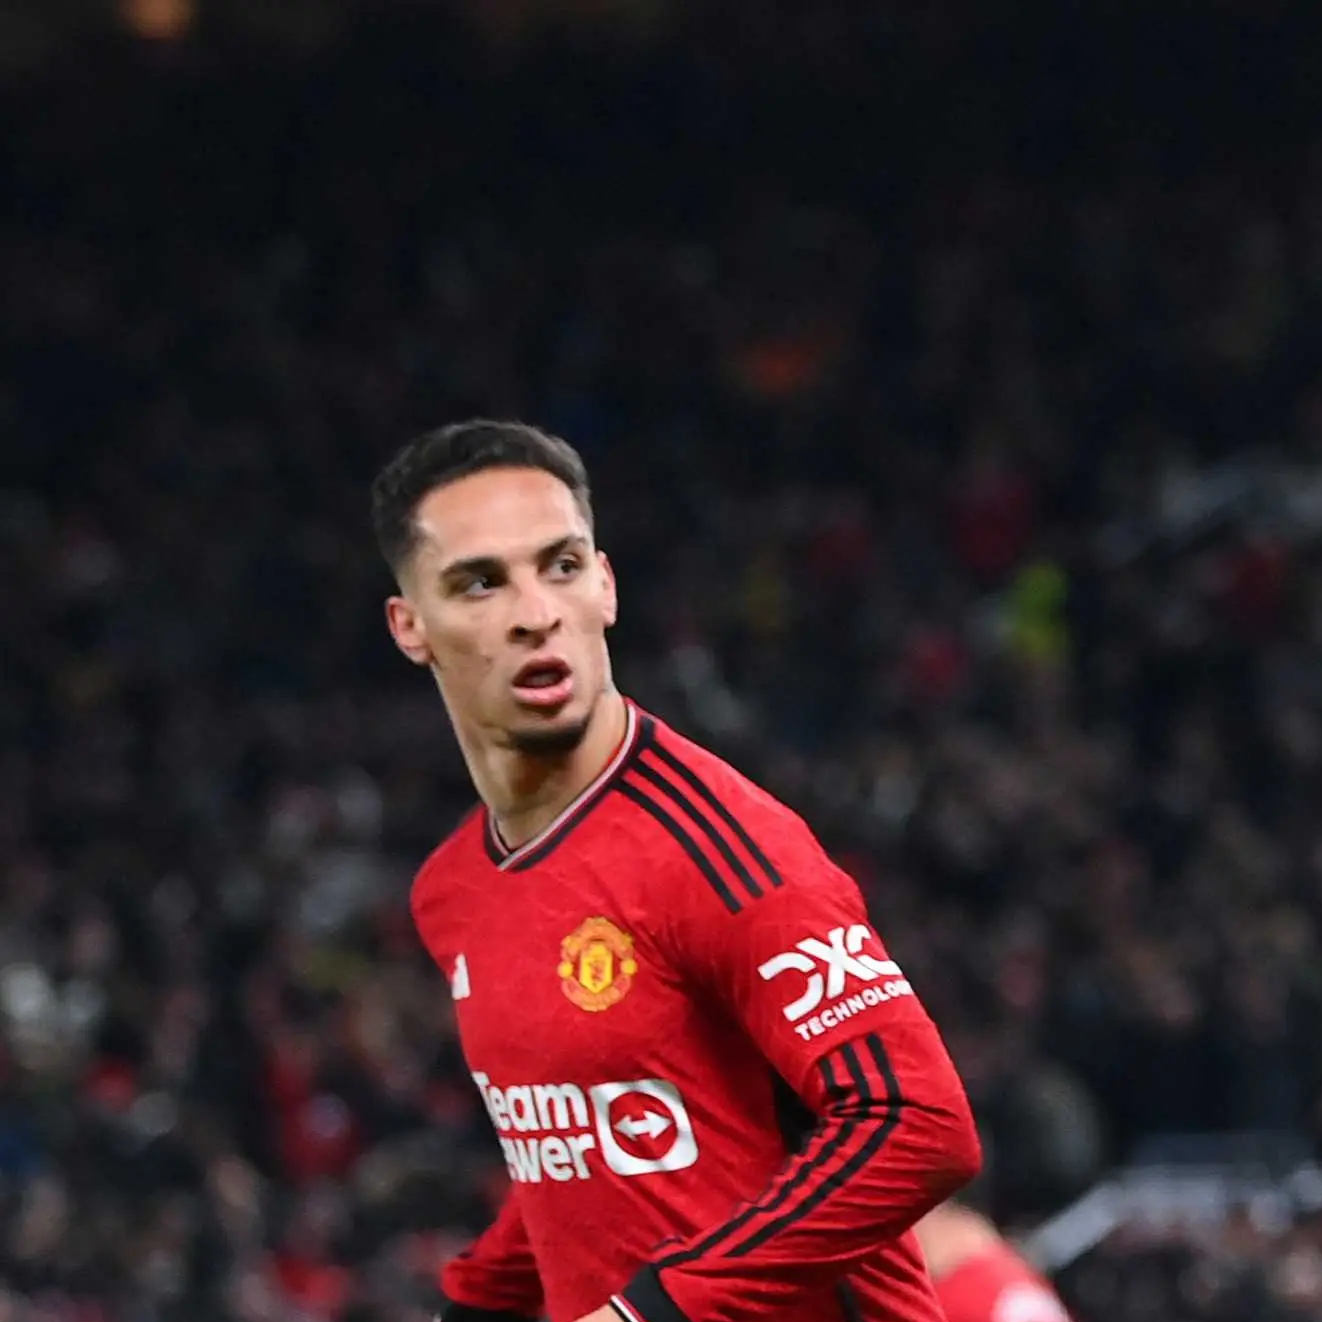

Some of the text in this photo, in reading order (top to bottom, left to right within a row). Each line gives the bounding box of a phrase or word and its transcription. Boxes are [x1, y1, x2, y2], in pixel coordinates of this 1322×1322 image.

[757, 924, 902, 1022] DXC
[472, 1071, 590, 1131] Team
[500, 1132, 596, 1183] wer
